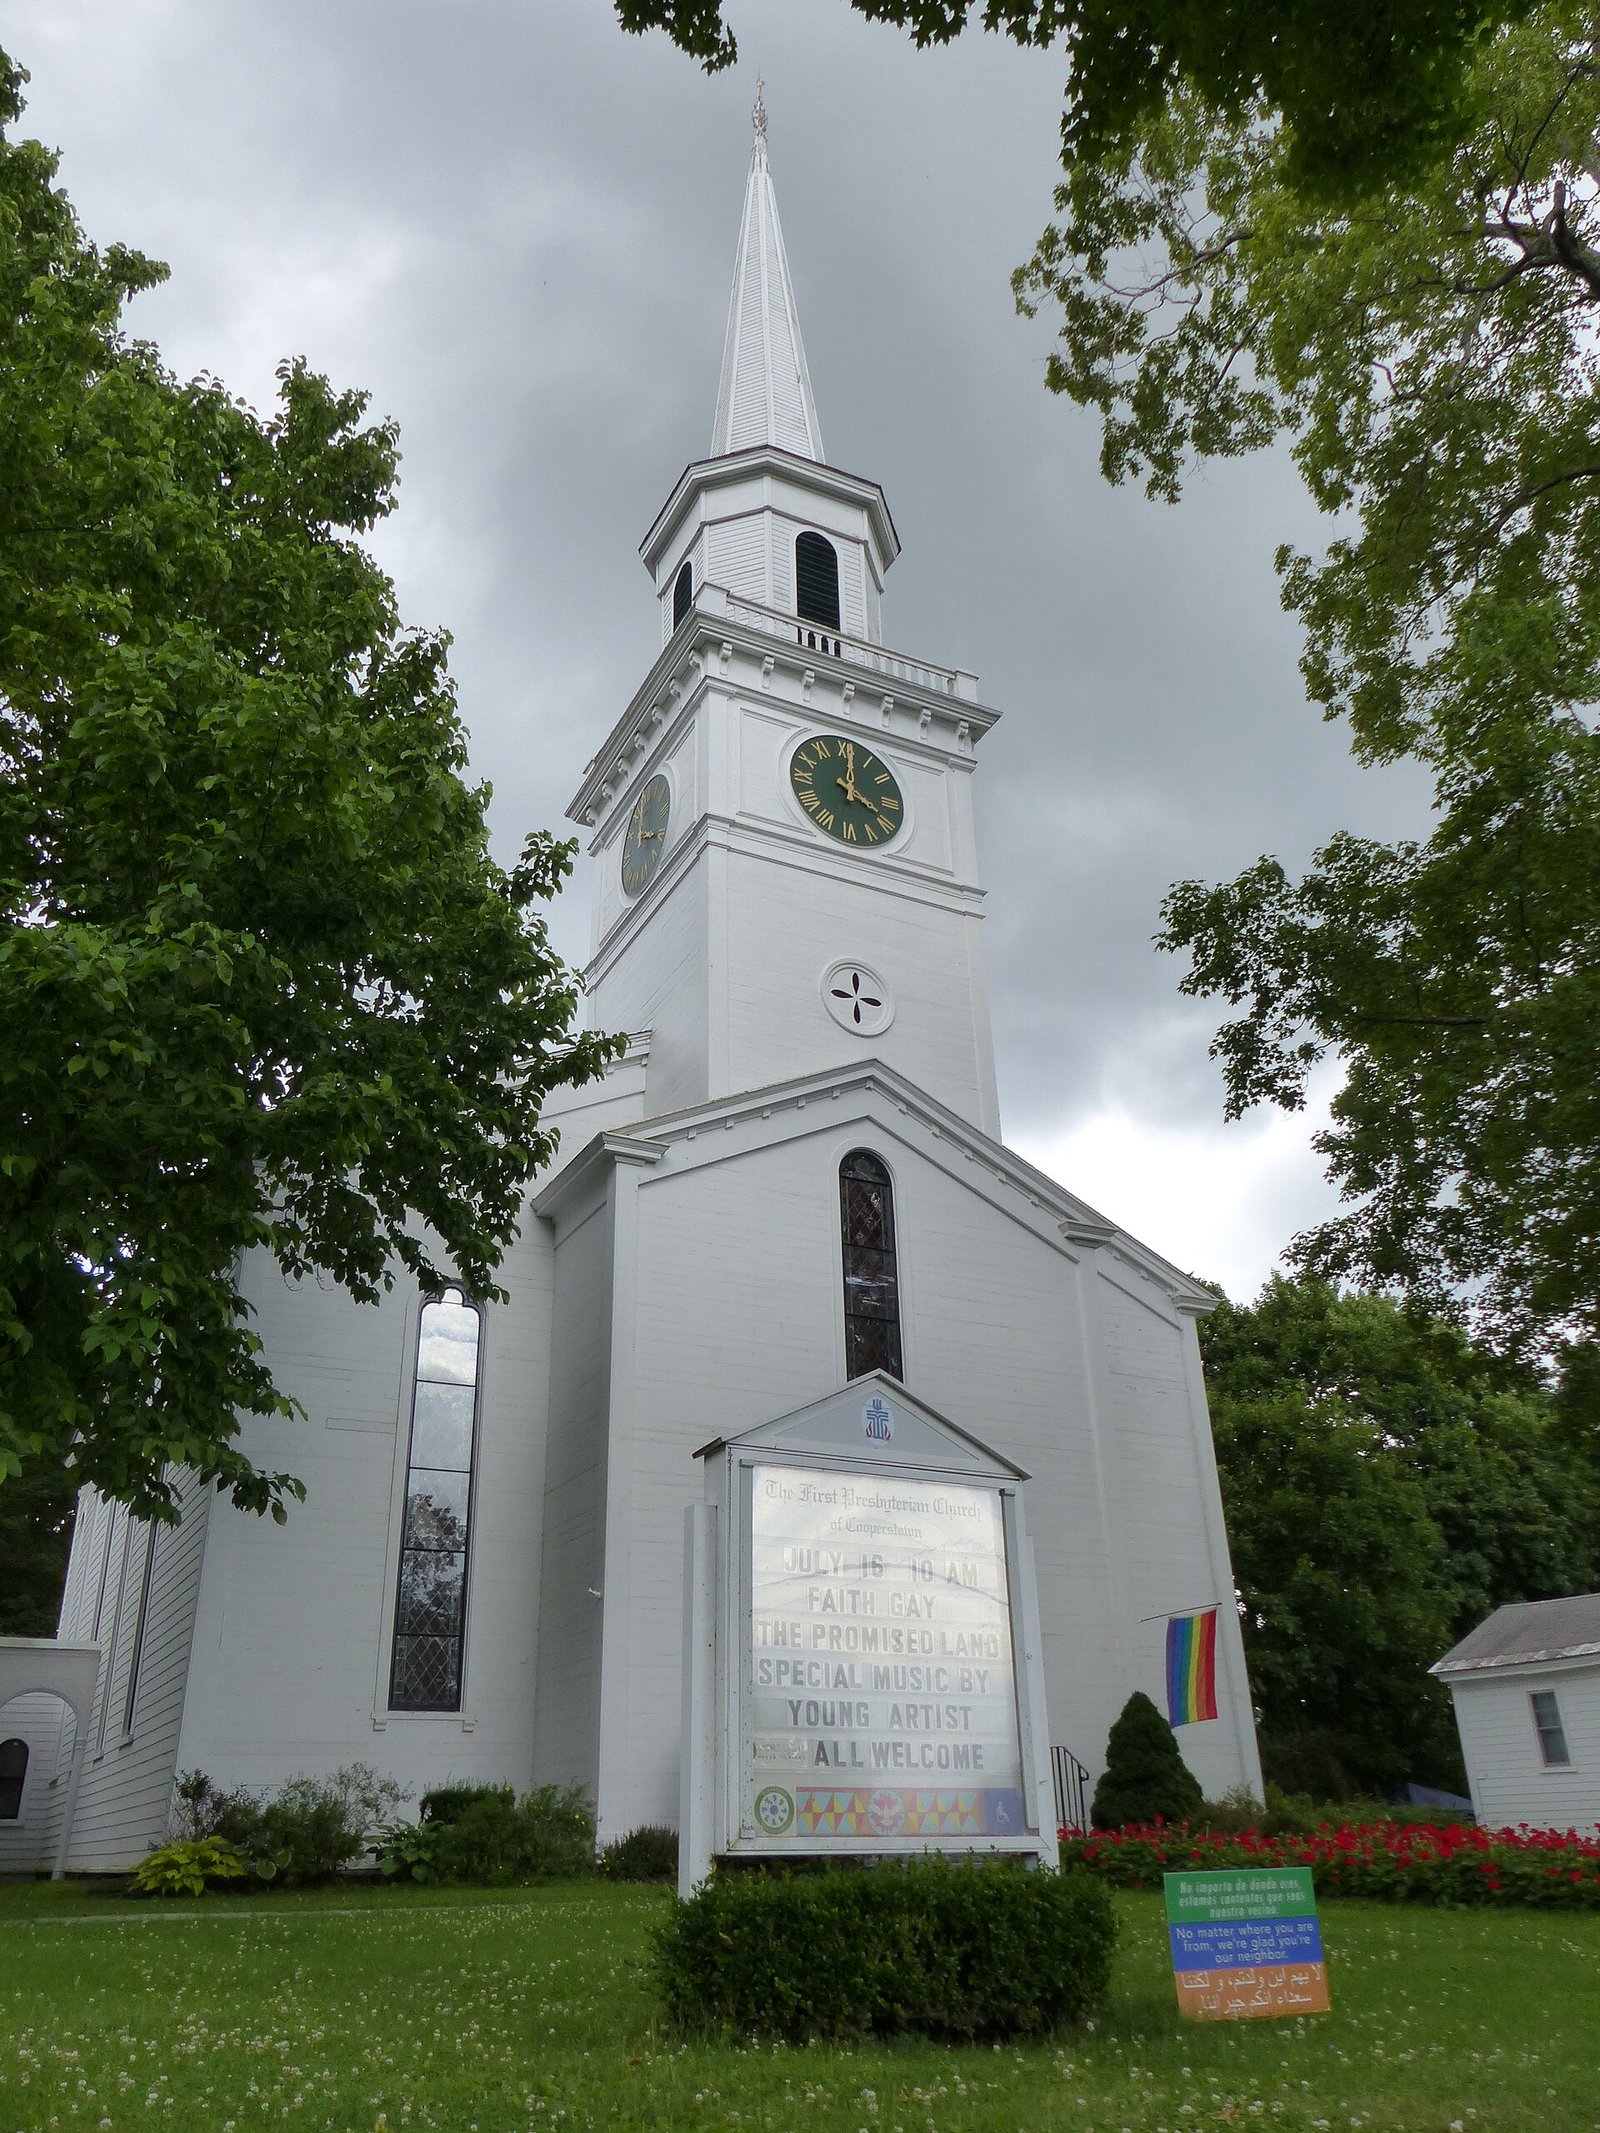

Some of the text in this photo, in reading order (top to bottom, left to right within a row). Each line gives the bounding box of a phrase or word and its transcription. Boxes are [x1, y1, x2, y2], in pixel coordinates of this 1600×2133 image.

[765, 1479, 982, 1521] The First Presbyterian Church
[829, 1517, 922, 1539] of Cooperstown
[784, 1547, 845, 1576] JULY
[945, 1560, 979, 1586] AM
[807, 1586, 936, 1619] FAITH GAY
[757, 1621, 1000, 1658] THE PROMISED LAND
[758, 1658, 990, 1693] SPECIAL MUSIC BY
[788, 1699, 973, 1730] YOUNG ARTIST
[814, 1740, 985, 1770] ALL WELCOME
[1176, 1921, 1314, 1940] No matter where you are
[1183, 1940, 1214, 1953] from,
[1251, 1934, 1276, 1952] glad
[1215, 1947, 1289, 1965] our neighbor.
